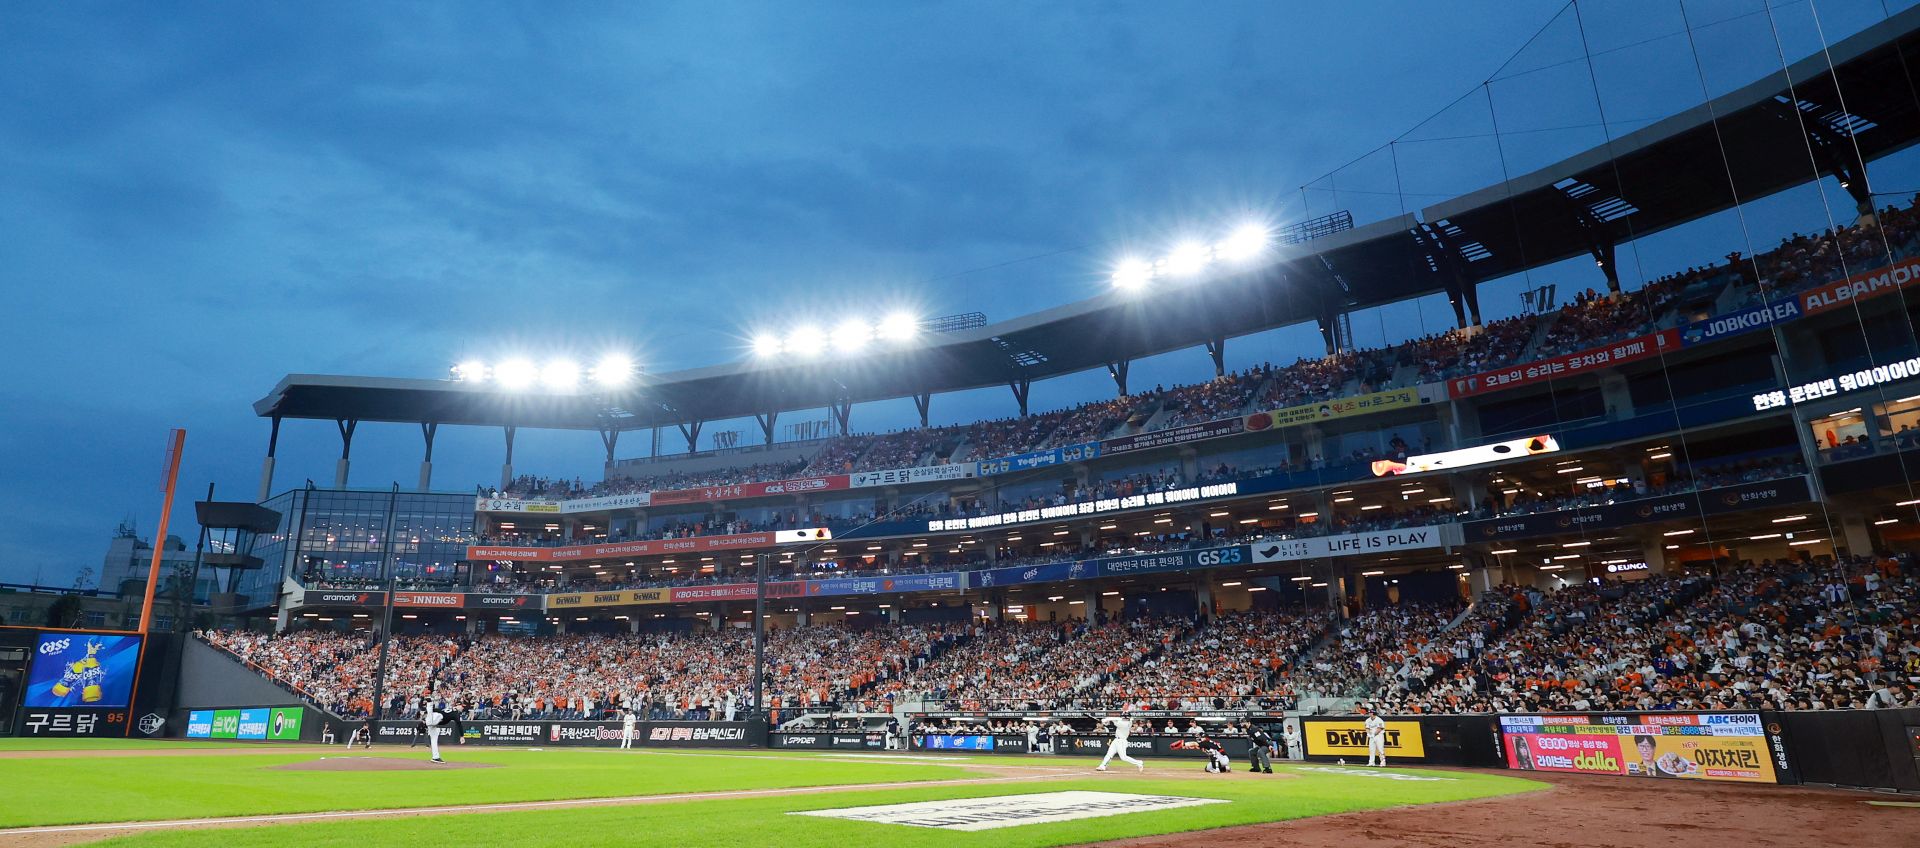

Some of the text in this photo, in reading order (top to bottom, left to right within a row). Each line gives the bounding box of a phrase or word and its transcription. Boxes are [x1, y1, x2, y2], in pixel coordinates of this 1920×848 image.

[1705, 302, 1798, 337] JOBKOREA
[1485, 342, 1646, 387] 오늘의 승리는 공차와 함께!
[1753, 391, 1787, 411] 한화
[1789, 378, 1838, 404] 문현빈
[869, 470, 911, 485] 구르닭
[1147, 492, 1164, 505] 위해
[1741, 489, 1777, 501] 한화생명
[1653, 502, 1686, 513] 한화생명
[1572, 514, 1603, 524] 한화생명
[1497, 523, 1525, 533] 한화생명
[1282, 543, 1307, 551] LIFE
[1328, 532, 1428, 552] LIFE IS PLAY
[1107, 556, 1184, 571] 대한민국 대표 편의점
[1197, 549, 1241, 566] GS25
[853, 580, 876, 593] 부루펜
[929, 576, 953, 588] 부루펜
[765, 583, 800, 595] VING
[322, 593, 357, 601] aramark
[412, 595, 457, 605] INNINGS
[482, 596, 515, 604] aramark
[40, 638, 71, 655] Cass
[26, 713, 98, 734] 구르닭
[107, 713, 124, 723] 95
[1602, 716, 1627, 725] 한화생명
[1648, 715, 1691, 725] 한화손해보험
[396, 728, 412, 736] 2025
[484, 725, 541, 736] 한국폴리텍대학
[560, 726, 640, 740] 주원산오리 Joown
[693, 727, 745, 740] 충남혁신도시
[1617, 726, 1631, 734] 당진
[787, 736, 816, 744] SPYDER
[1083, 740, 1102, 748] 아워홈
[1326, 730, 1401, 747] DEWLT
[1127, 741, 1152, 749] RHOME
[1694, 748, 1760, 769] 야자치킨
[1772, 735, 1788, 770] 한화생명
[1536, 750, 1620, 771] 라이브는 dalla
